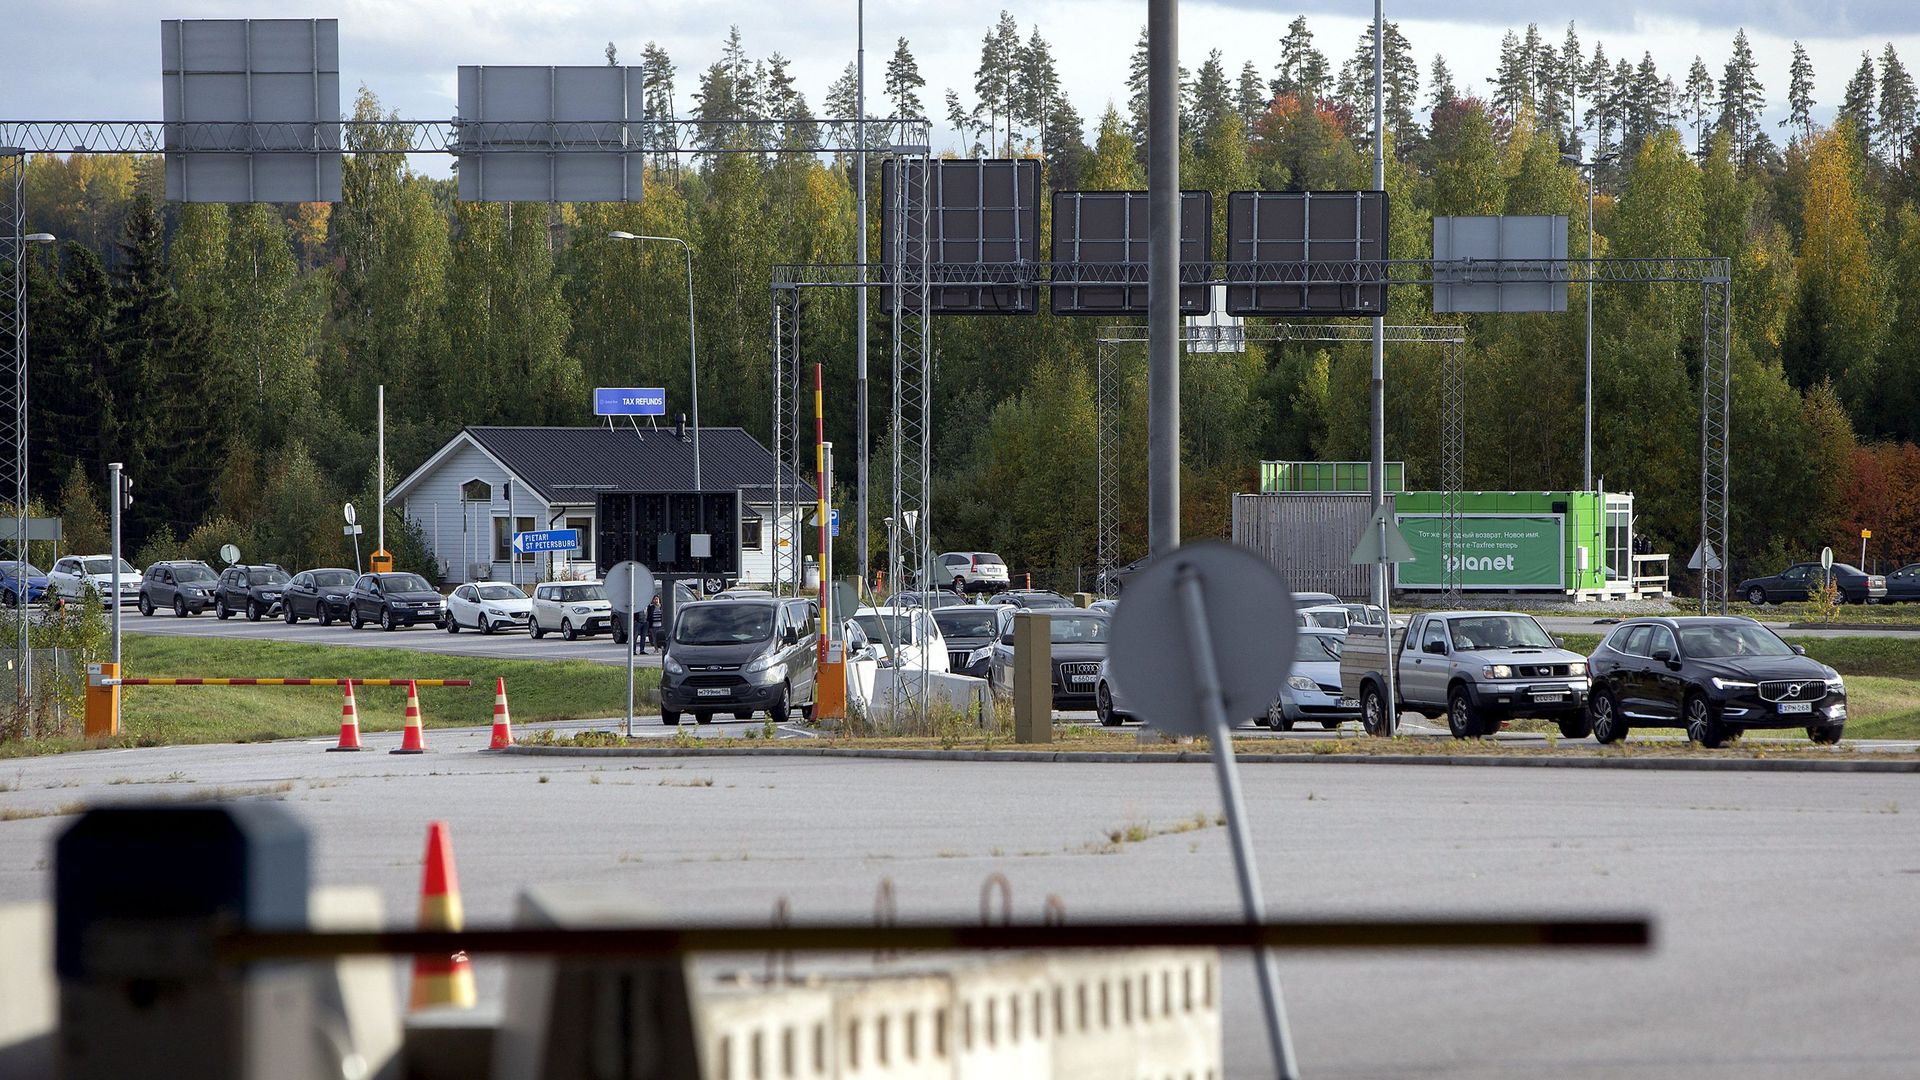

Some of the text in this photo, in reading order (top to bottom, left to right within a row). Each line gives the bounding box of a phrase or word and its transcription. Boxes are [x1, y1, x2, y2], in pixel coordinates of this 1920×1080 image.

[525, 534, 549, 542] PIETARI
[535, 540, 576, 549] PETERSBURG
[1466, 541, 1495, 549] e-Taxfree
[1444, 554, 1514, 572] planet
